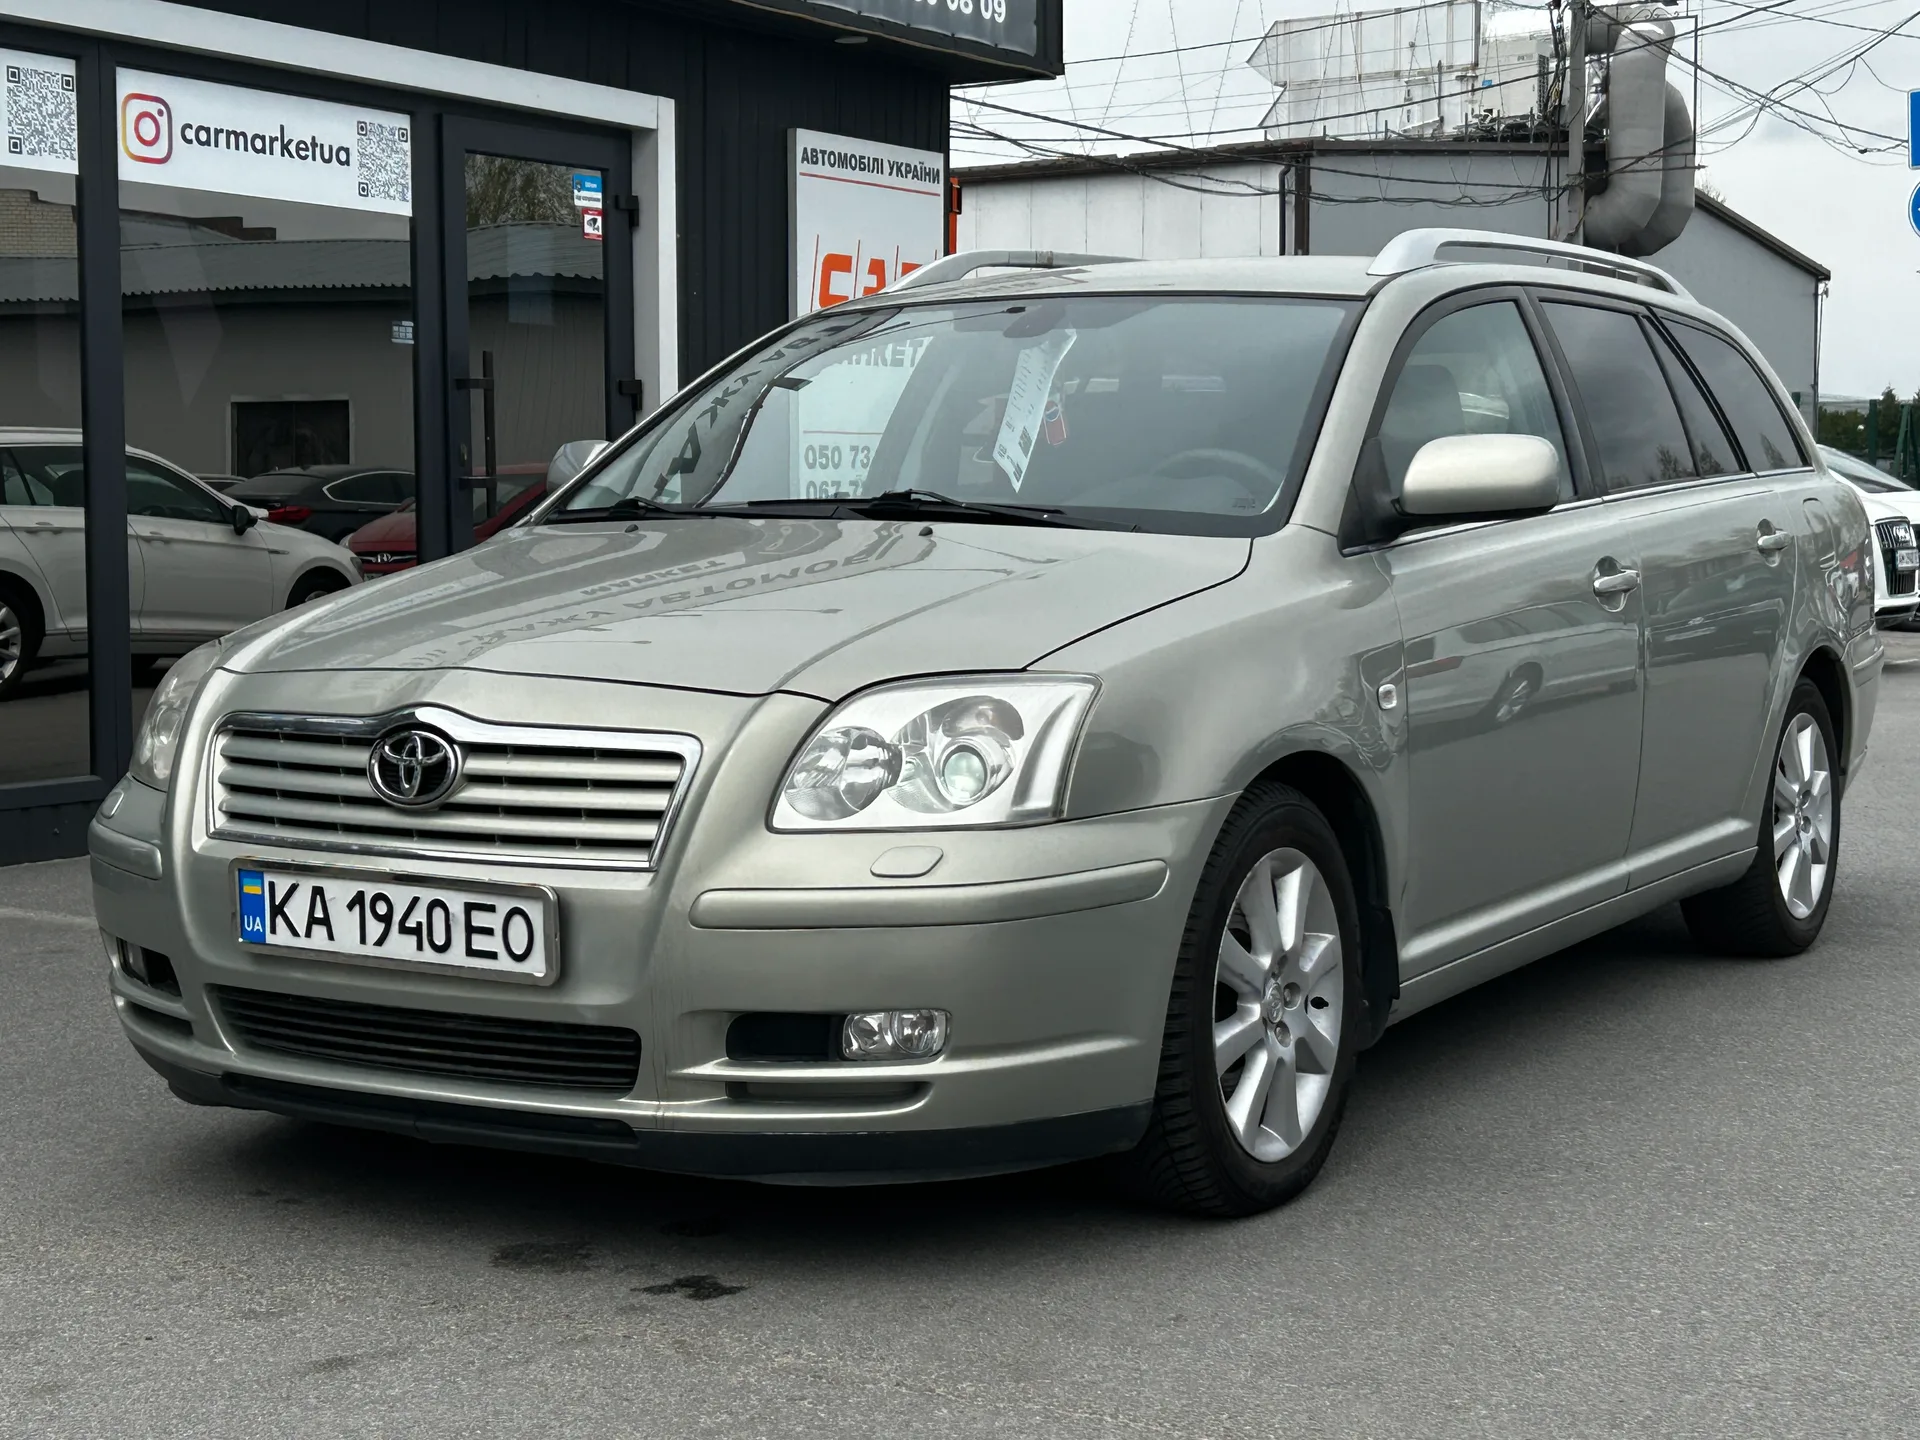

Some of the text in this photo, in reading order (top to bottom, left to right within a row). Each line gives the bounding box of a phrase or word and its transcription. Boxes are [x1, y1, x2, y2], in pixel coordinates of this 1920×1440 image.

[980, 0, 1006, 23] 09
[180, 123, 351, 167] carmarketua
[800, 146, 941, 185] АВТОМОБІЛІ УКРАЇНИ
[804, 444, 871, 470] 050 73
[244, 915, 264, 933] UA
[267, 880, 536, 963] KA 1940 EO
